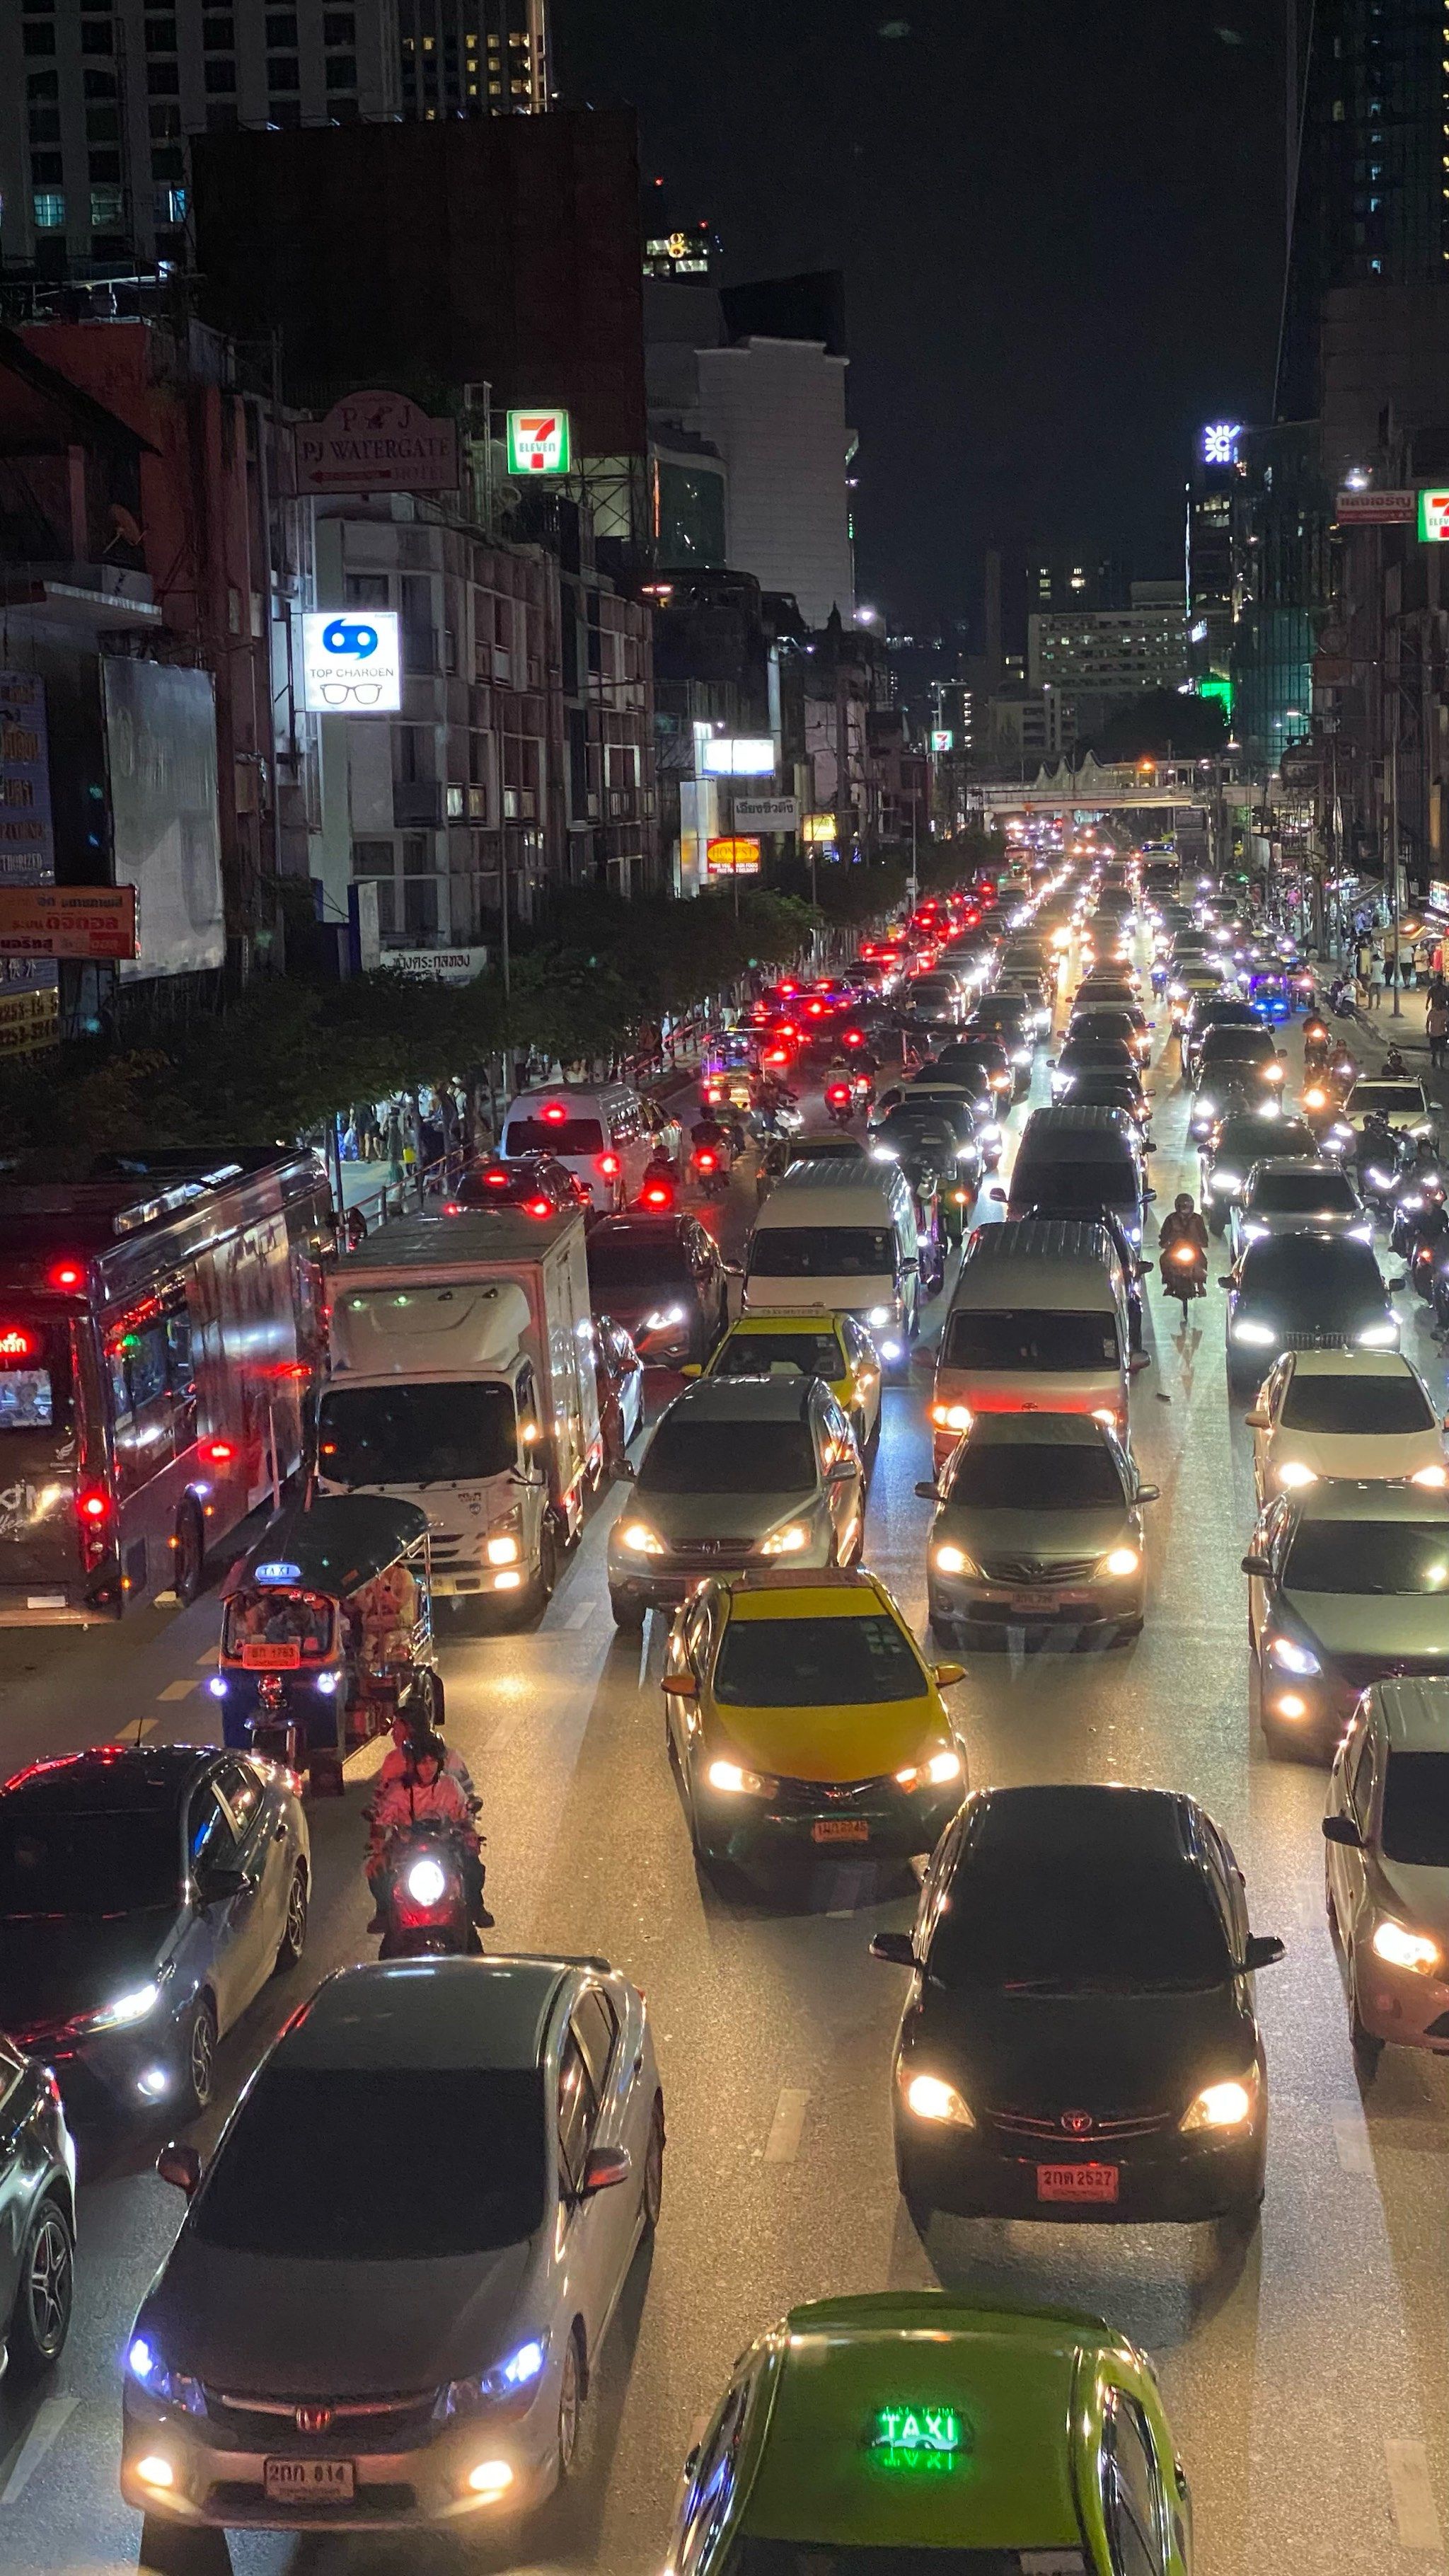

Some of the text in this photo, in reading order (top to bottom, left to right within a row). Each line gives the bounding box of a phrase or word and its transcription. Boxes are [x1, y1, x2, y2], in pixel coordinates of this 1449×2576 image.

[303, 437, 451, 461] PJ WATERGATE
[310, 668, 394, 678] TOP CHAROEN
[882, 2413, 954, 2442] TAXI
